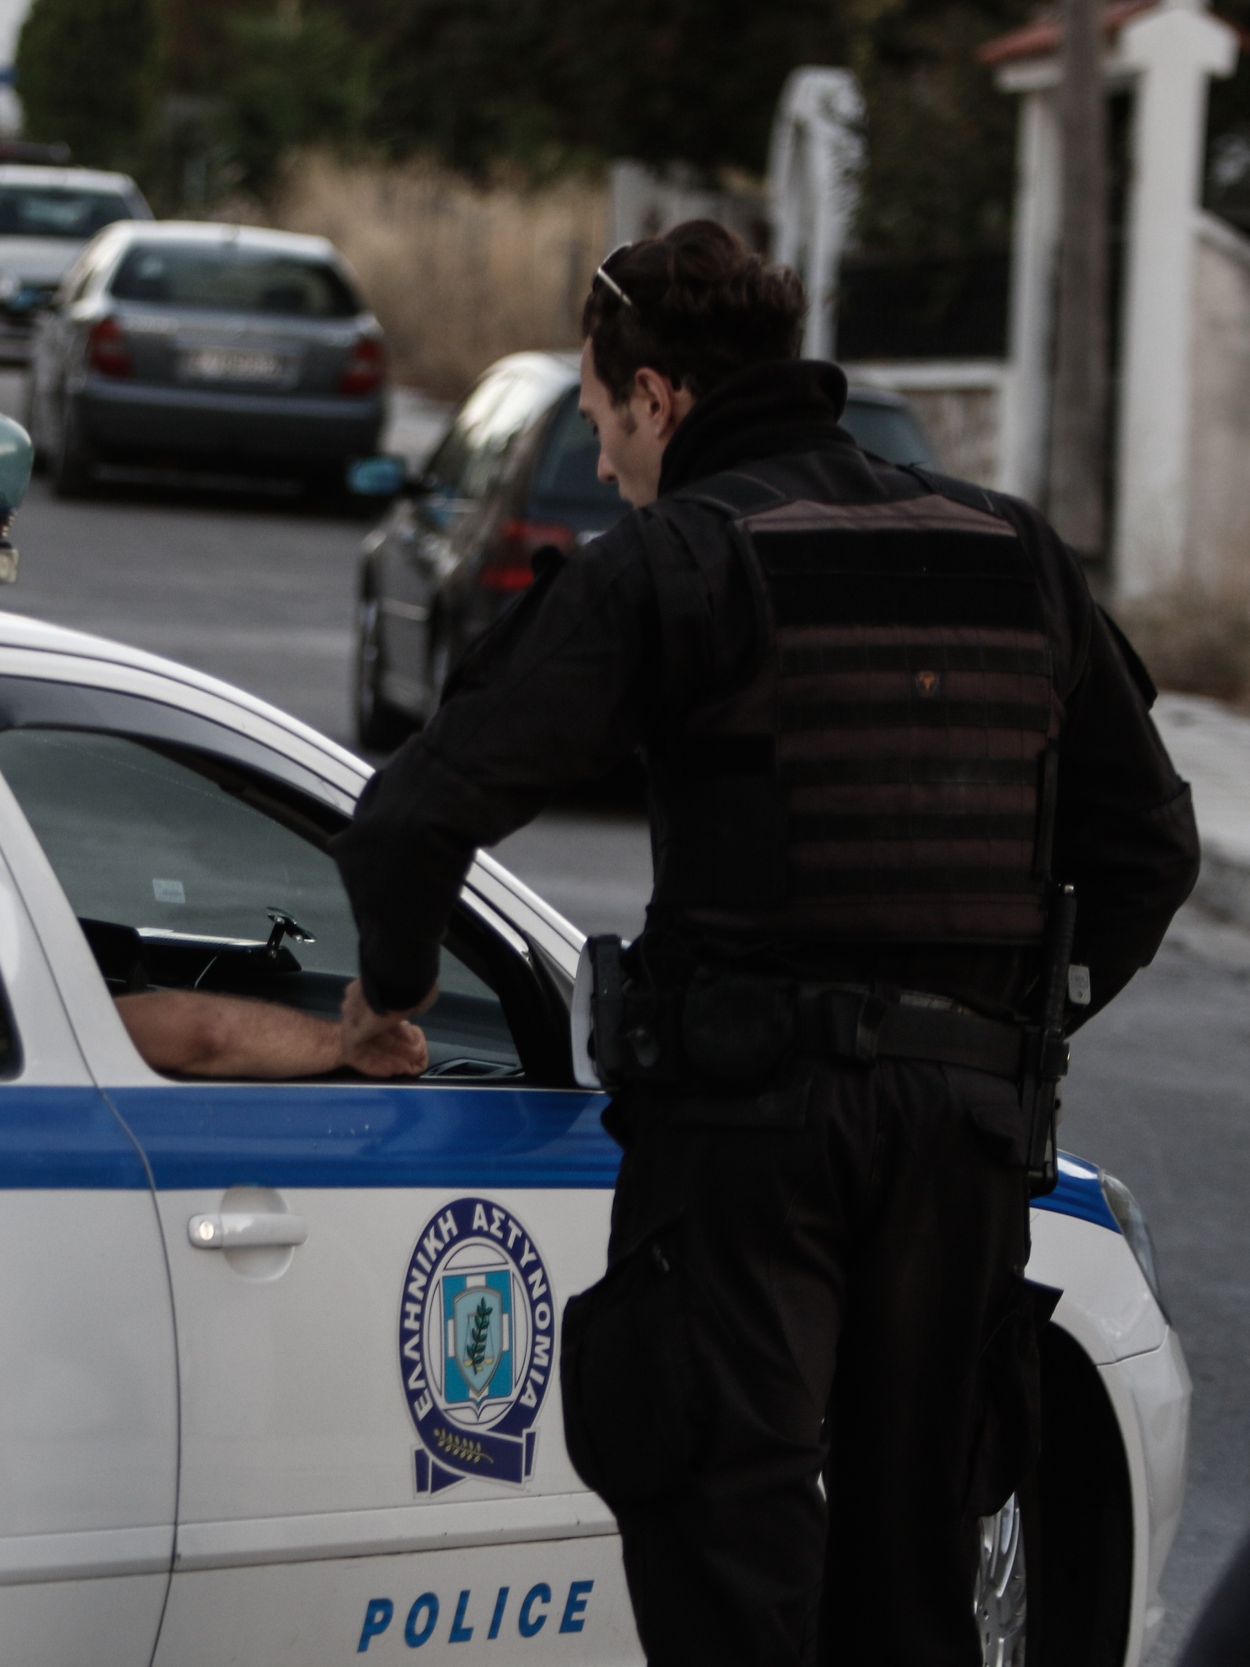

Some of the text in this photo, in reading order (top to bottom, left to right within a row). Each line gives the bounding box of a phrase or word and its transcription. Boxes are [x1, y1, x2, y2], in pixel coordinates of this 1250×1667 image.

[404, 1203, 551, 1421] ΕΛΛΗΝΙΚΗ ΑΣΤΥΝΟΜΙΑ
[357, 1579, 595, 1653] POLICE
